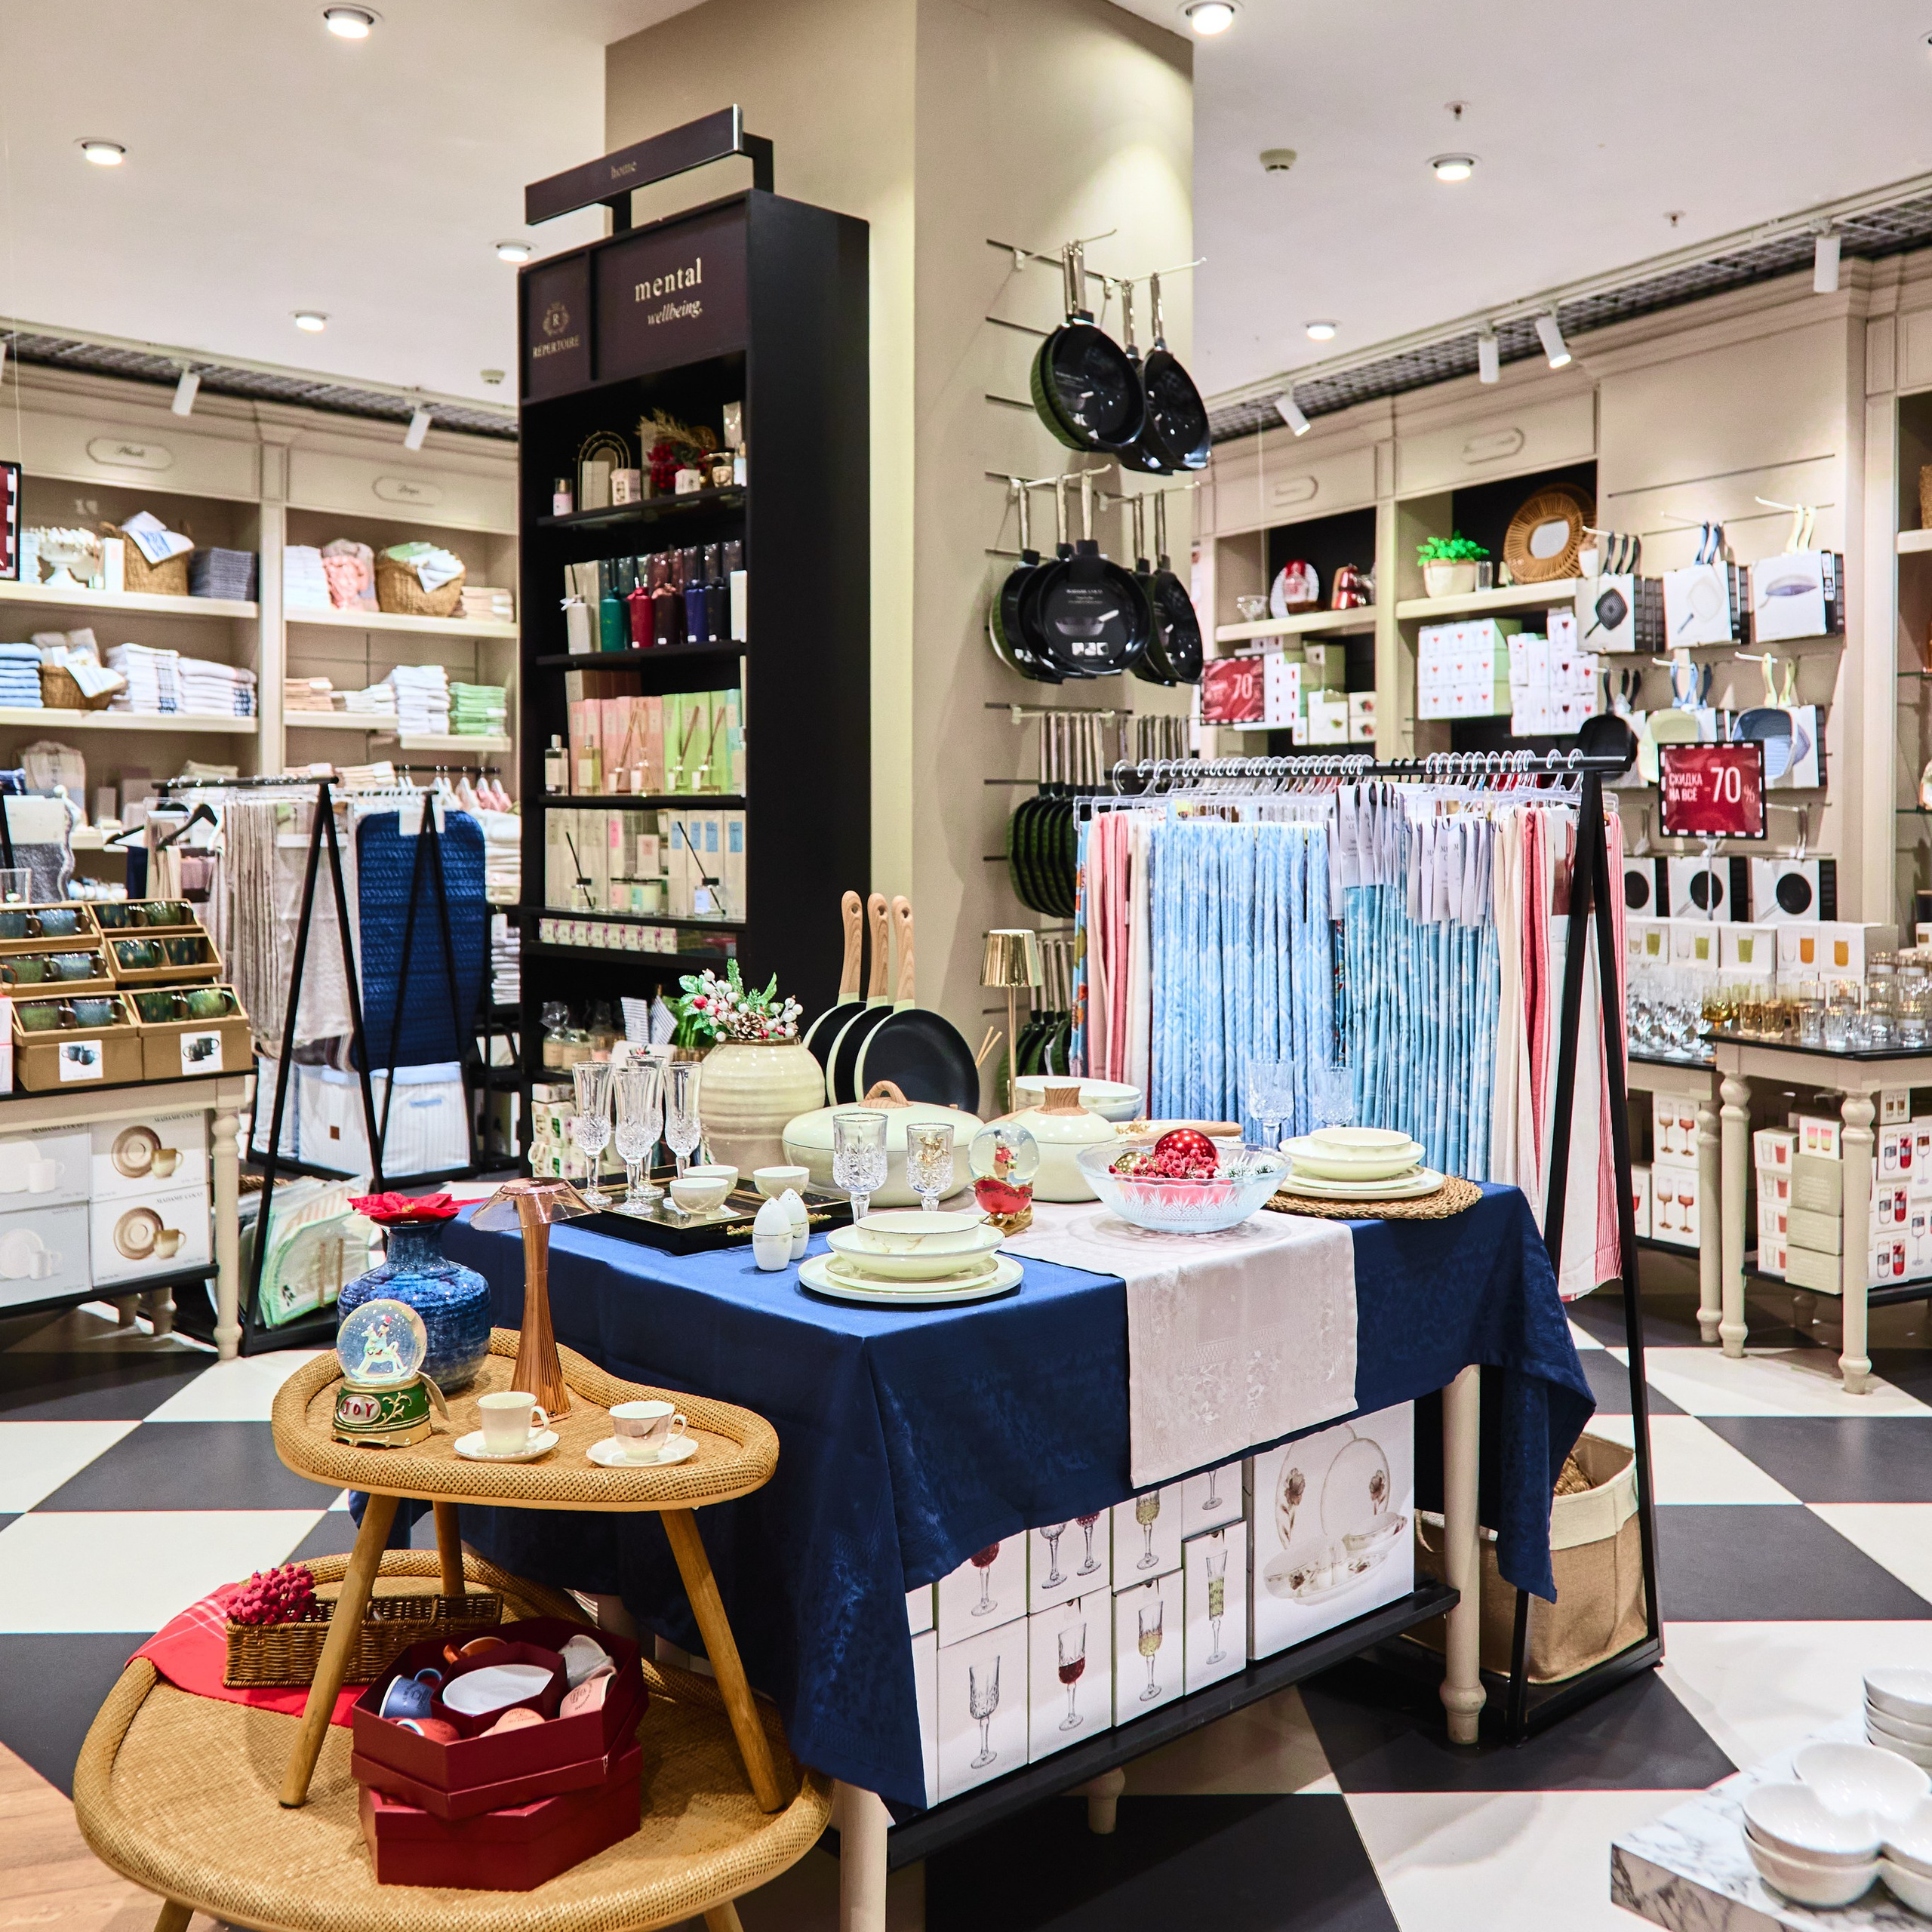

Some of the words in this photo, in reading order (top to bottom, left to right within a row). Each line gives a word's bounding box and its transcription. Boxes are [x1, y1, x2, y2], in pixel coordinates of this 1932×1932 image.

[611, 162, 637, 179] home
[635, 257, 702, 302] mental
[1669, 772, 1703, 786] СКИДКА
[1669, 788, 1680, 801] НА
[340, 1400, 375, 1417] JOY
